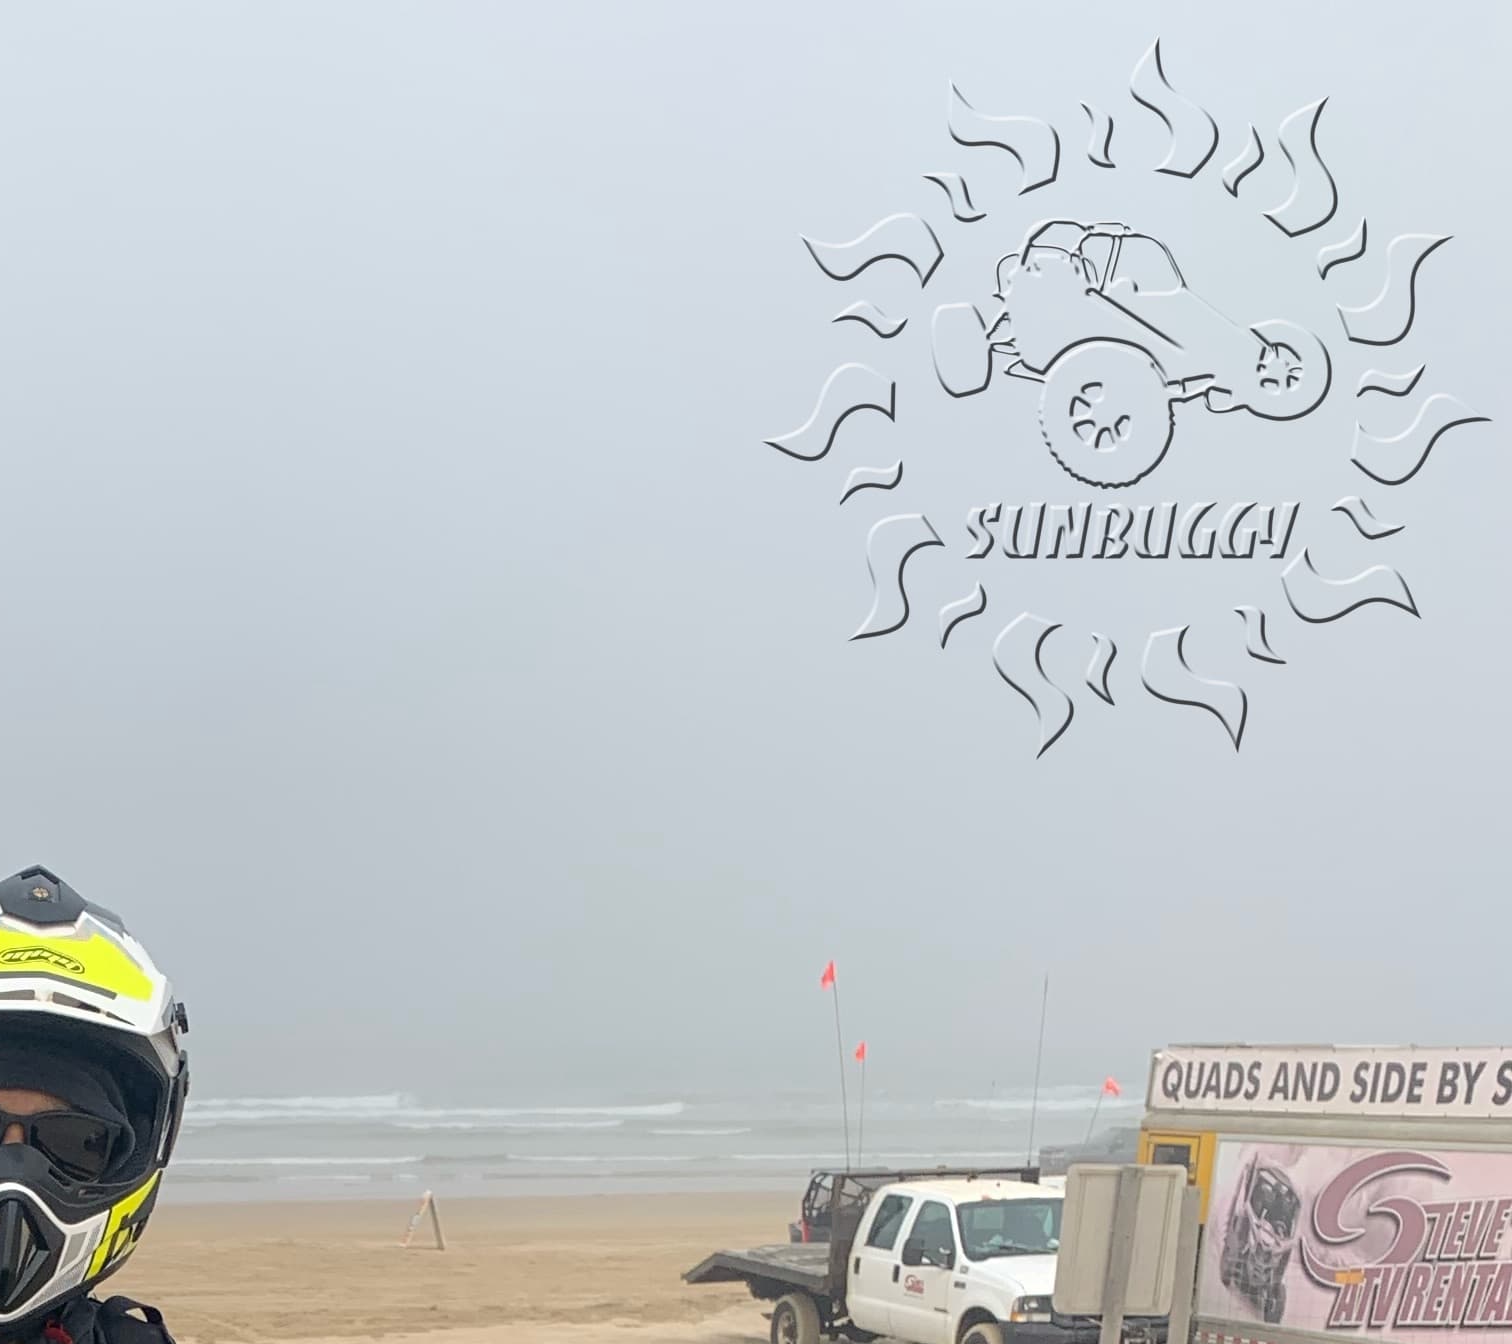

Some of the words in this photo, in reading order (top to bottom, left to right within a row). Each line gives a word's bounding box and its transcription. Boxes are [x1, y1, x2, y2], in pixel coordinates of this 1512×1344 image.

[1162, 1060, 1262, 1102] QUADS
[1268, 1061, 1341, 1102] AND
[1350, 1061, 1428, 1104] SIDE
[1436, 1061, 1487, 1105] BY
[1328, 1264, 1408, 1329] ATV
